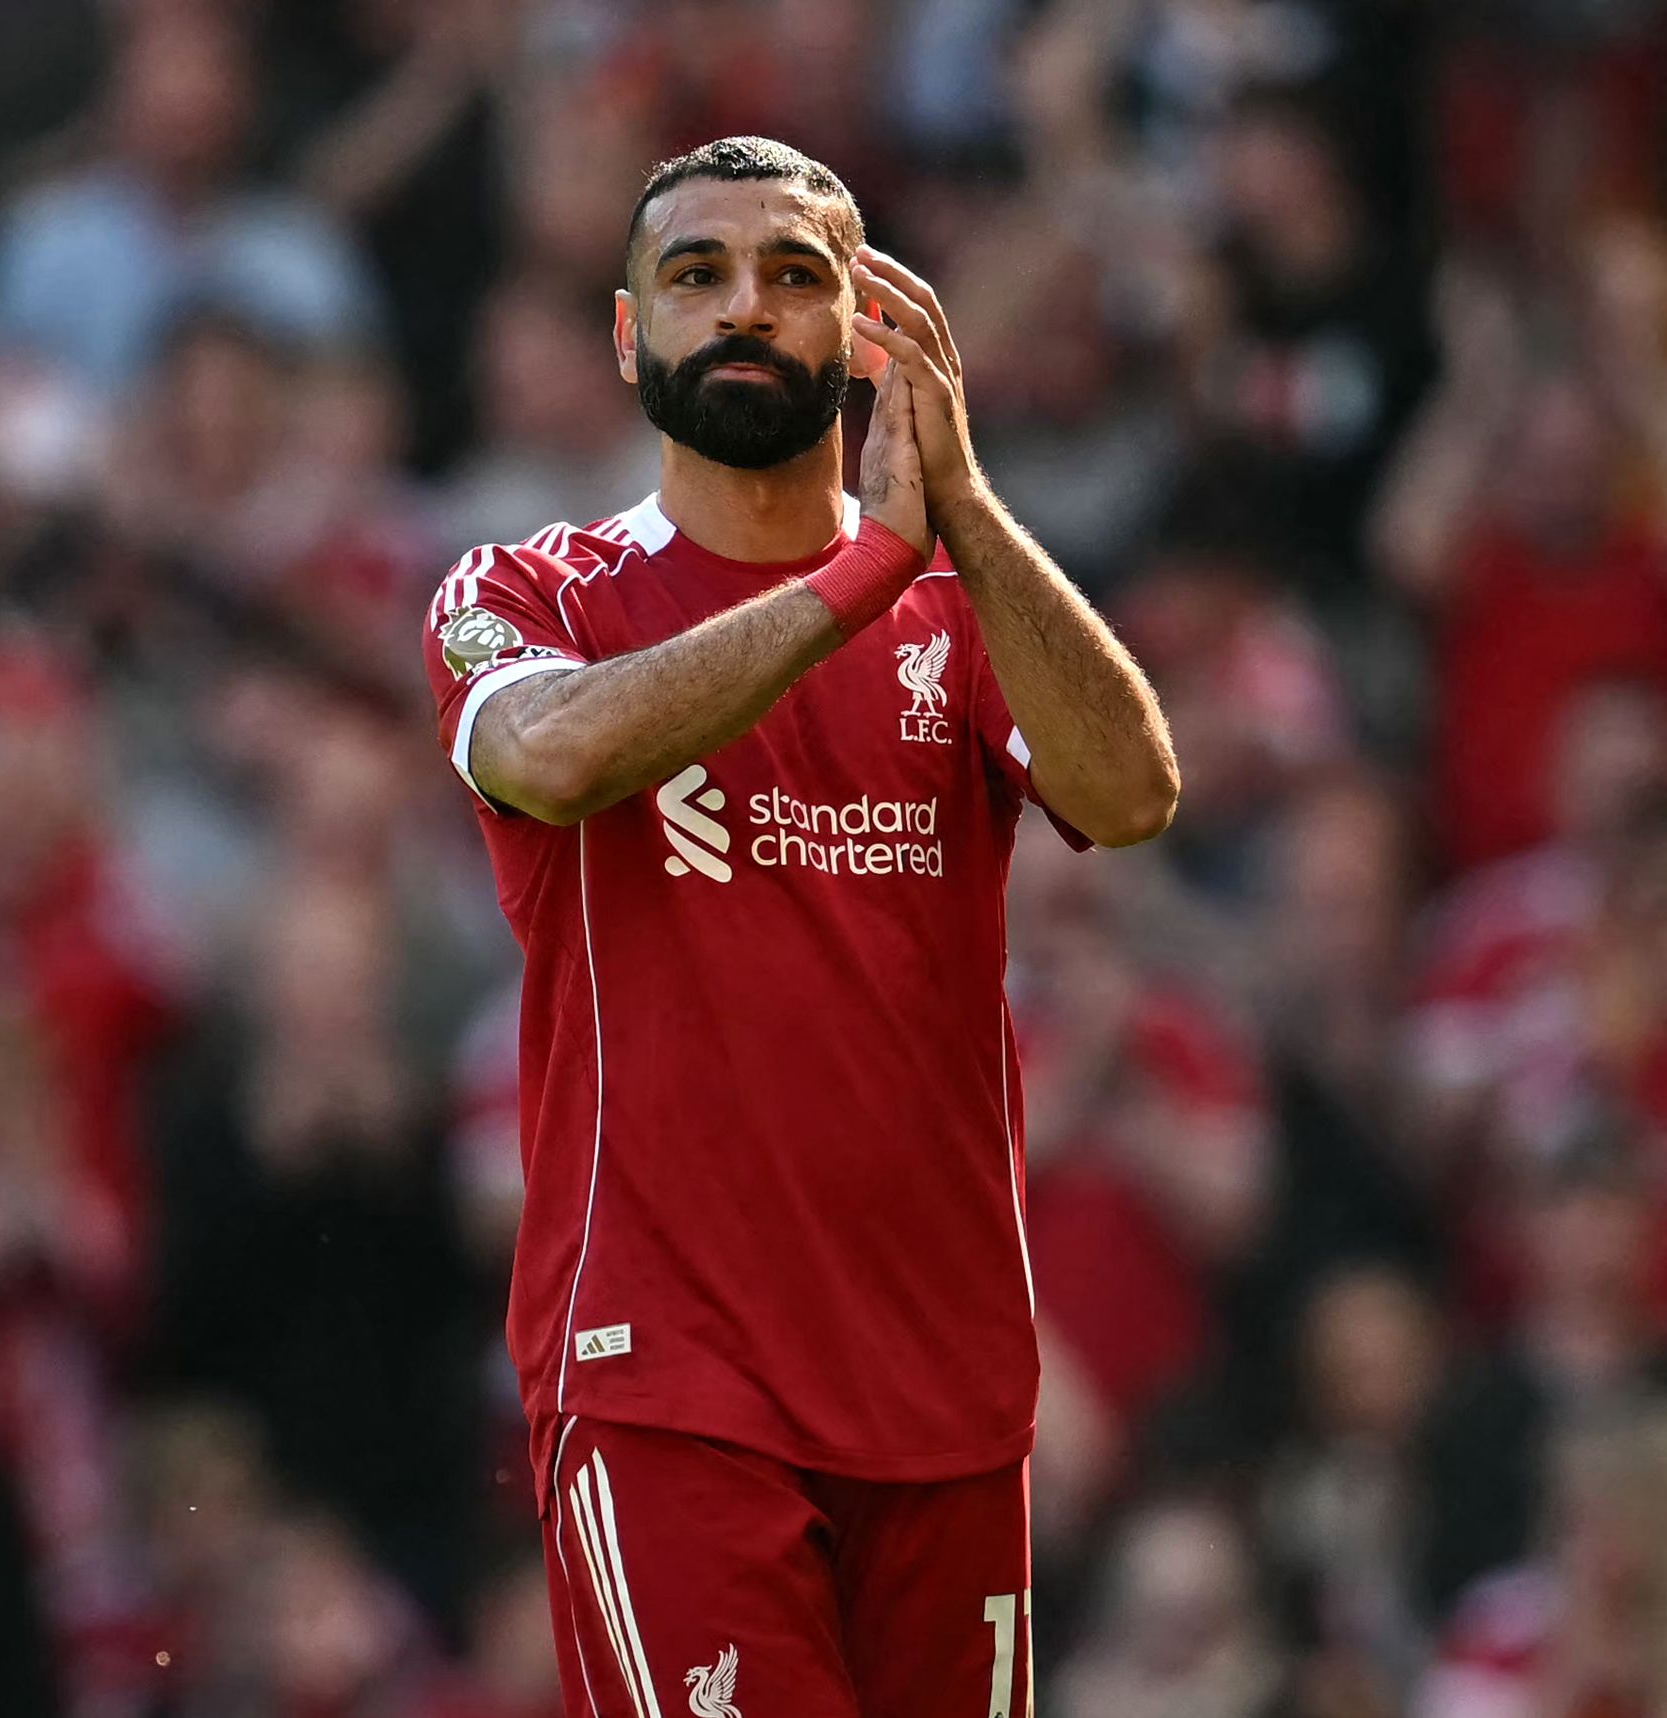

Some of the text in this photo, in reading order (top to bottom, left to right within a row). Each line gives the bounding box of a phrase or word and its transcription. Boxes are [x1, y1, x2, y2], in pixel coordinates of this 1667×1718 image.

[899, 718, 952, 744] L.F.C.
[749, 786, 937, 835] standard
[751, 827, 943, 878] chartered
